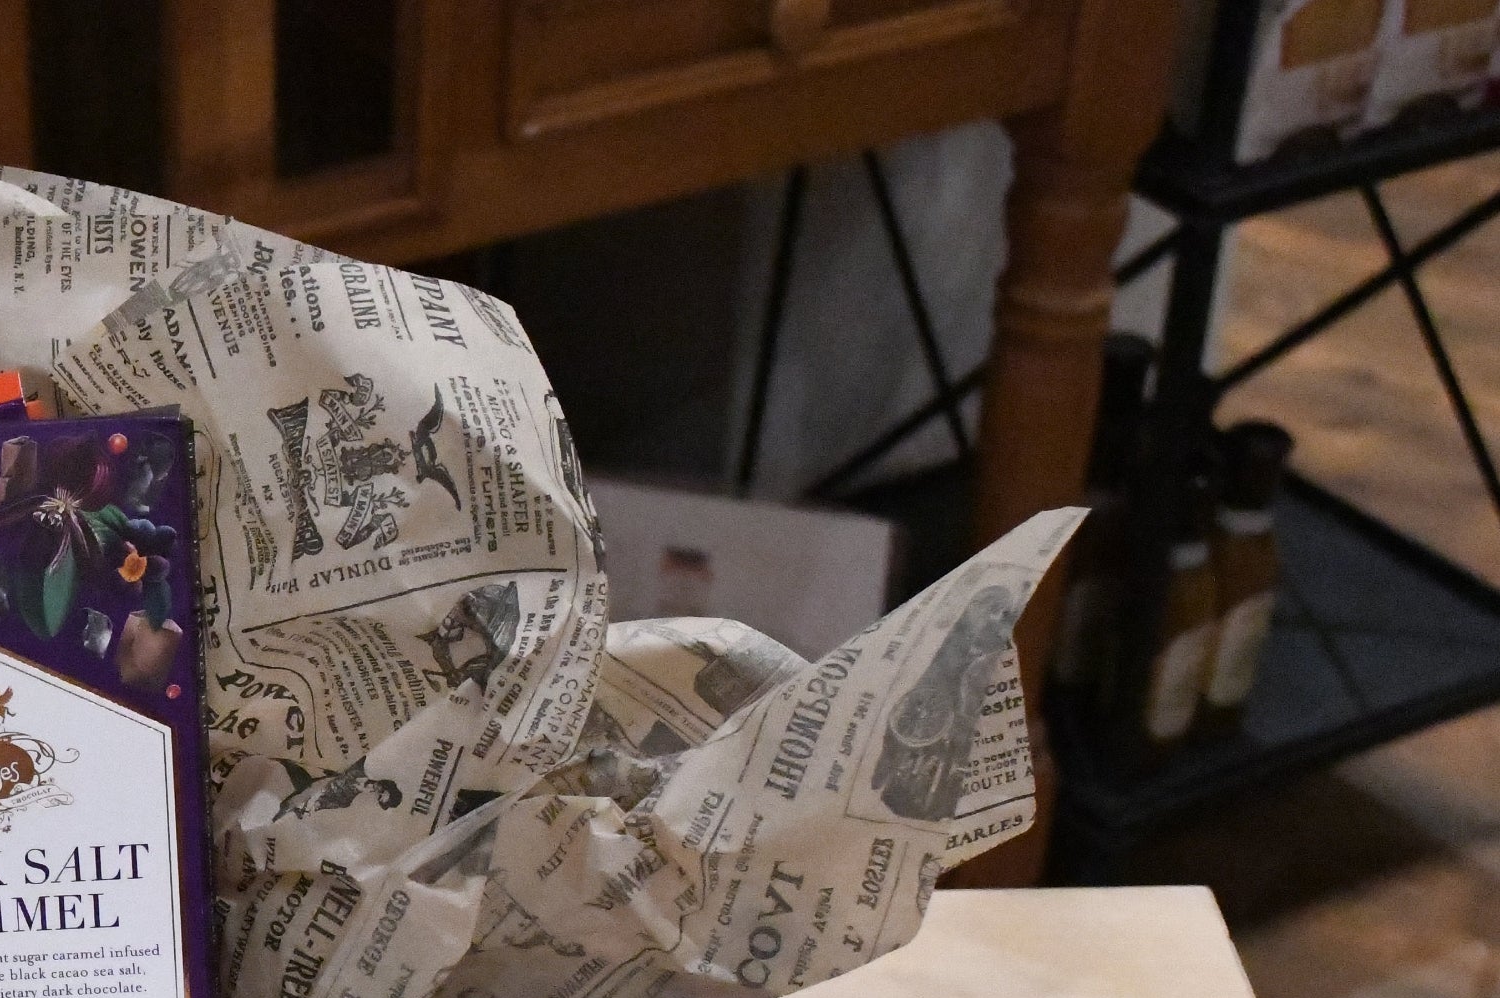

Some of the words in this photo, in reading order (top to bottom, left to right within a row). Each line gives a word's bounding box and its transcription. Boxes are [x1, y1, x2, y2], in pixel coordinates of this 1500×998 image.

[61, 222, 72, 236] OF
[61, 239, 72, 263] THE
[60, 265, 72, 294] EYES.
[299, 265, 326, 334] ations
[149, 349, 186, 391] House
[322, 449, 339, 484] STATE
[504, 444, 517, 456] &
[480, 465, 497, 554] Furriers
[508, 459, 530, 534] SHAFER
[309, 555, 392, 589] DUNLAP
[200, 574, 221, 650] The
[216, 667, 306, 758] Power
[472, 720, 502, 759] STITCH
[525, 678, 579, 772] COMPANY
[409, 737, 454, 817] POWERFUL
[23, 843, 150, 886] SALT
[264, 873, 313, 952] MOTOR
[9, 966, 47, 981] black
[51, 967, 89, 979] cacao
[92, 965, 114, 977] sea
[118, 963, 146, 977] salt,
[12, 951, 49, 970] sugar
[52, 947, 105, 961] caramel
[109, 943, 160, 958] infused
[42, 981, 73, 998] dark
[77, 980, 148, 996] chocolate.
